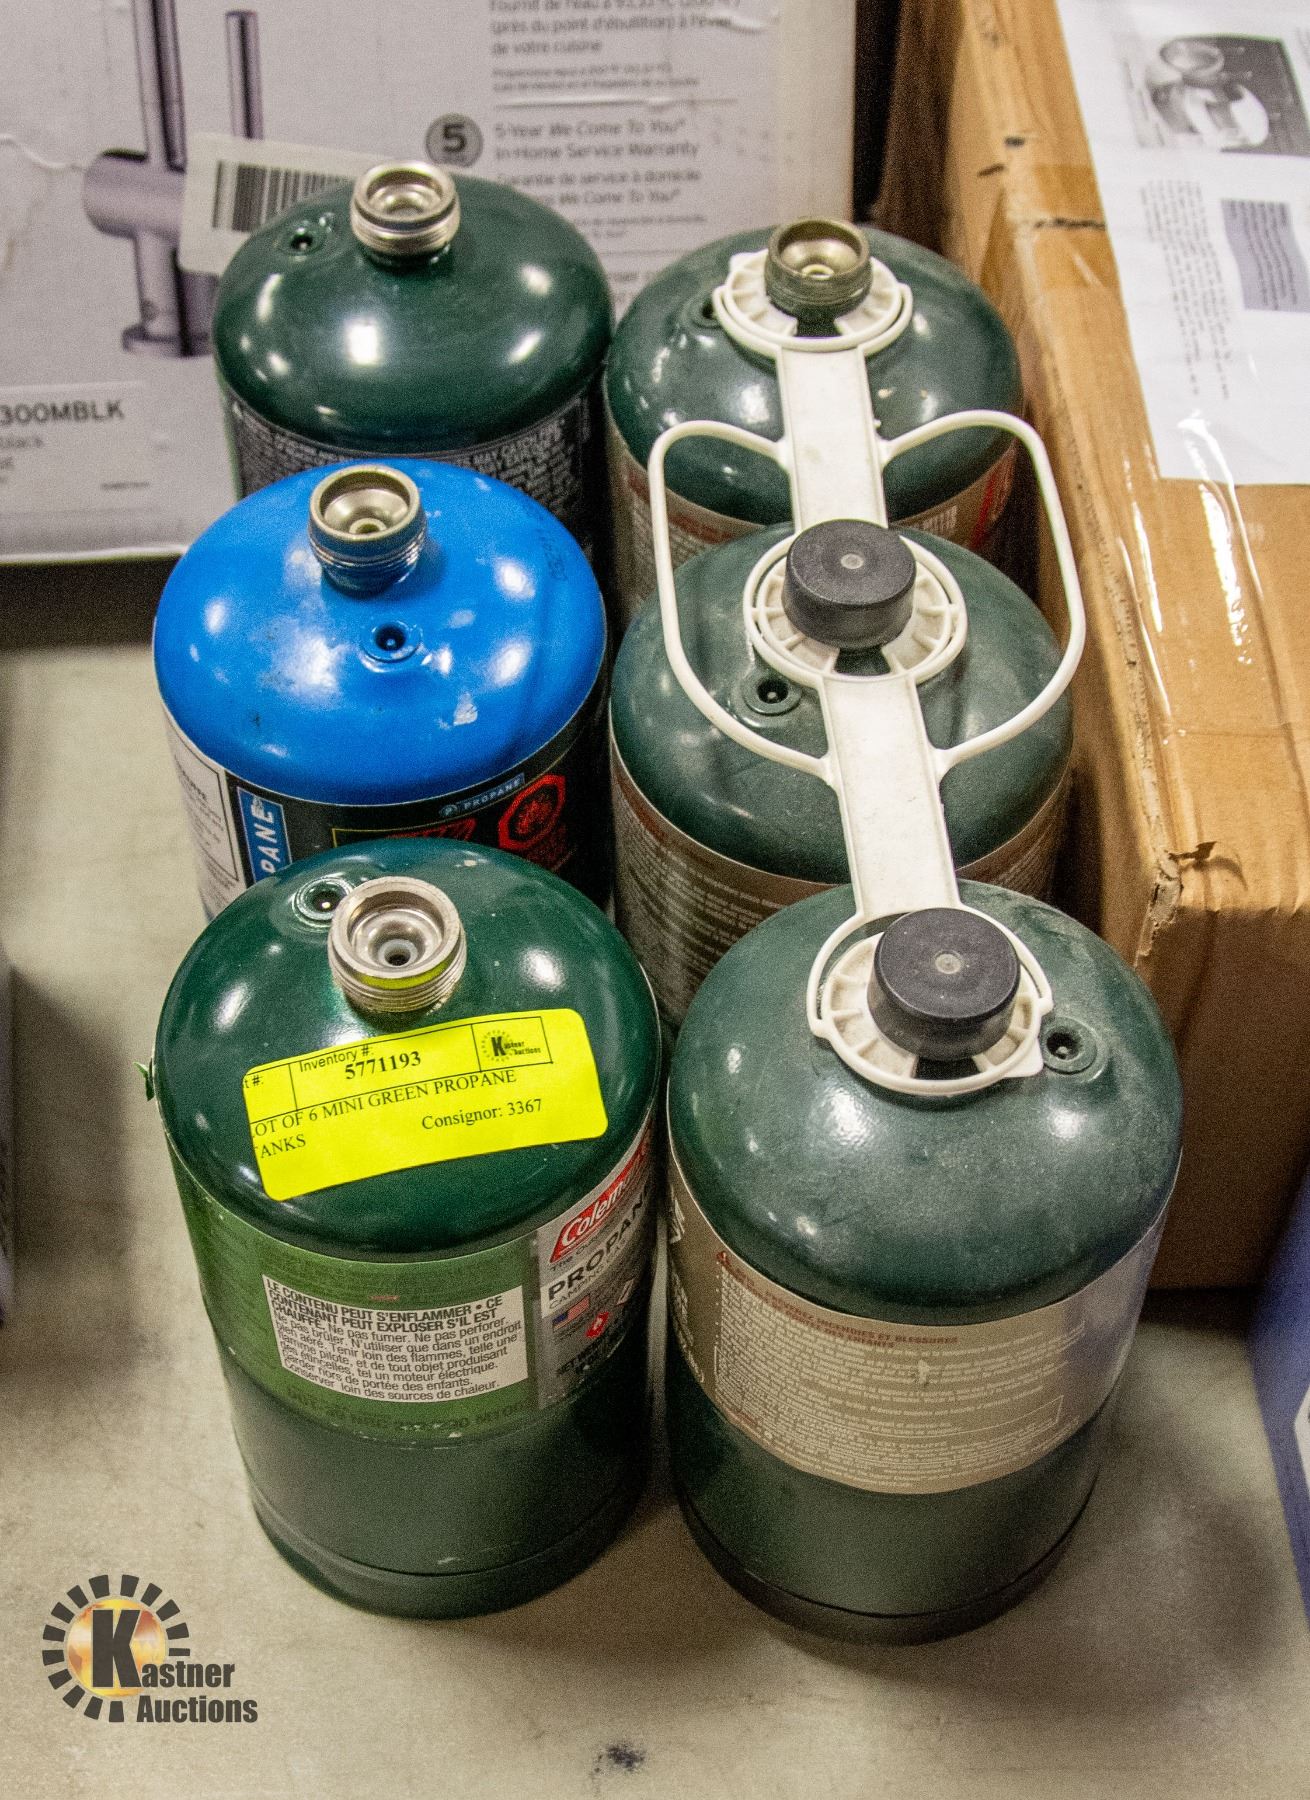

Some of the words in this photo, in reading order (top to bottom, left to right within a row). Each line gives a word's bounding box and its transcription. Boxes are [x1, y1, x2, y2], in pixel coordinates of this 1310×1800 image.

[443, 122, 468, 152] 5
[550, 122, 572, 137] We
[576, 119, 622, 136] Come
[628, 118, 645, 133] To
[567, 143, 624, 159] Service
[628, 141, 698, 159] Warranty
[580, 172, 627, 186] service
[582, 190, 624, 205] Come
[629, 188, 646, 203] To
[464, 779, 521, 810] PROPANE
[299, 1049, 358, 1073] Inventory
[345, 1050, 422, 1080] 5771193
[252, 1118, 278, 1138] OT
[282, 1111, 304, 1130] OF
[309, 1107, 318, 1122] 6
[322, 1096, 364, 1119] MINI
[368, 1083, 429, 1108] GREEN
[434, 1069, 518, 1096] PROPANE
[422, 1106, 503, 1131] Consignor:
[507, 1097, 543, 1117] 3367
[254, 1133, 307, 1159] ANKS
[266, 1279, 280, 1293] LE
[282, 1288, 339, 1315] CONTENU
[341, 1306, 374, 1320] PEUT
[376, 1305, 472, 1323] S'ENFLAMMER
[486, 1296, 503, 1309] CE
[268, 1289, 338, 1324] CONTENANT
[342, 1316, 373, 1331] PEUT
[376, 1319, 444, 1333] EXPLOSER
[447, 1317, 471, 1330] S'IL
[474, 1308, 498, 1323] EST
[290, 1320, 310, 1335] pas
[406, 1344, 430, 1356] que
[432, 1339, 462, 1352] dans
[464, 1335, 480, 1347] un
[482, 1320, 522, 1342] endroit
[328, 1322, 344, 1335] Ne
[347, 1329, 369, 1341] pas
[371, 1331, 411, 1343] fumer.
[414, 1332, 432, 1343] Ne
[434, 1330, 456, 1343] pas
[459, 1316, 509, 1340] perforer.
[330, 1342, 359, 1357] Tenir
[362, 1350, 383, 1361] loin
[386, 1352, 408, 1363] des
[410, 1349, 467, 1363] flammes,
[469, 1341, 494, 1355] telle
[496, 1333, 518, 1347] une
[356, 1358, 368, 1369] et
[370, 1361, 386, 1371] de
[389, 1361, 411, 1373] tout
[414, 1360, 444, 1374] objet
[446, 1346, 508, 1371] produisant
[284, 1357, 335, 1388] Conserver
[340, 1381, 361, 1395] loin
[364, 1387, 386, 1400] des
[388, 1390, 434, 1401] sources
[436, 1390, 451, 1400] de
[454, 1380, 500, 1398] chaleur.
[318, 1365, 343, 1382] hors
[345, 1374, 360, 1386] de
[362, 1378, 399, 1393] portée
[402, 1380, 424, 1391] des
[426, 1378, 473, 1391] enfants.
[357, 1367, 372, 1378] tel
[374, 1370, 390, 1380] un
[393, 1372, 435, 1382] moteur
[438, 1361, 499, 1381] électrique.
